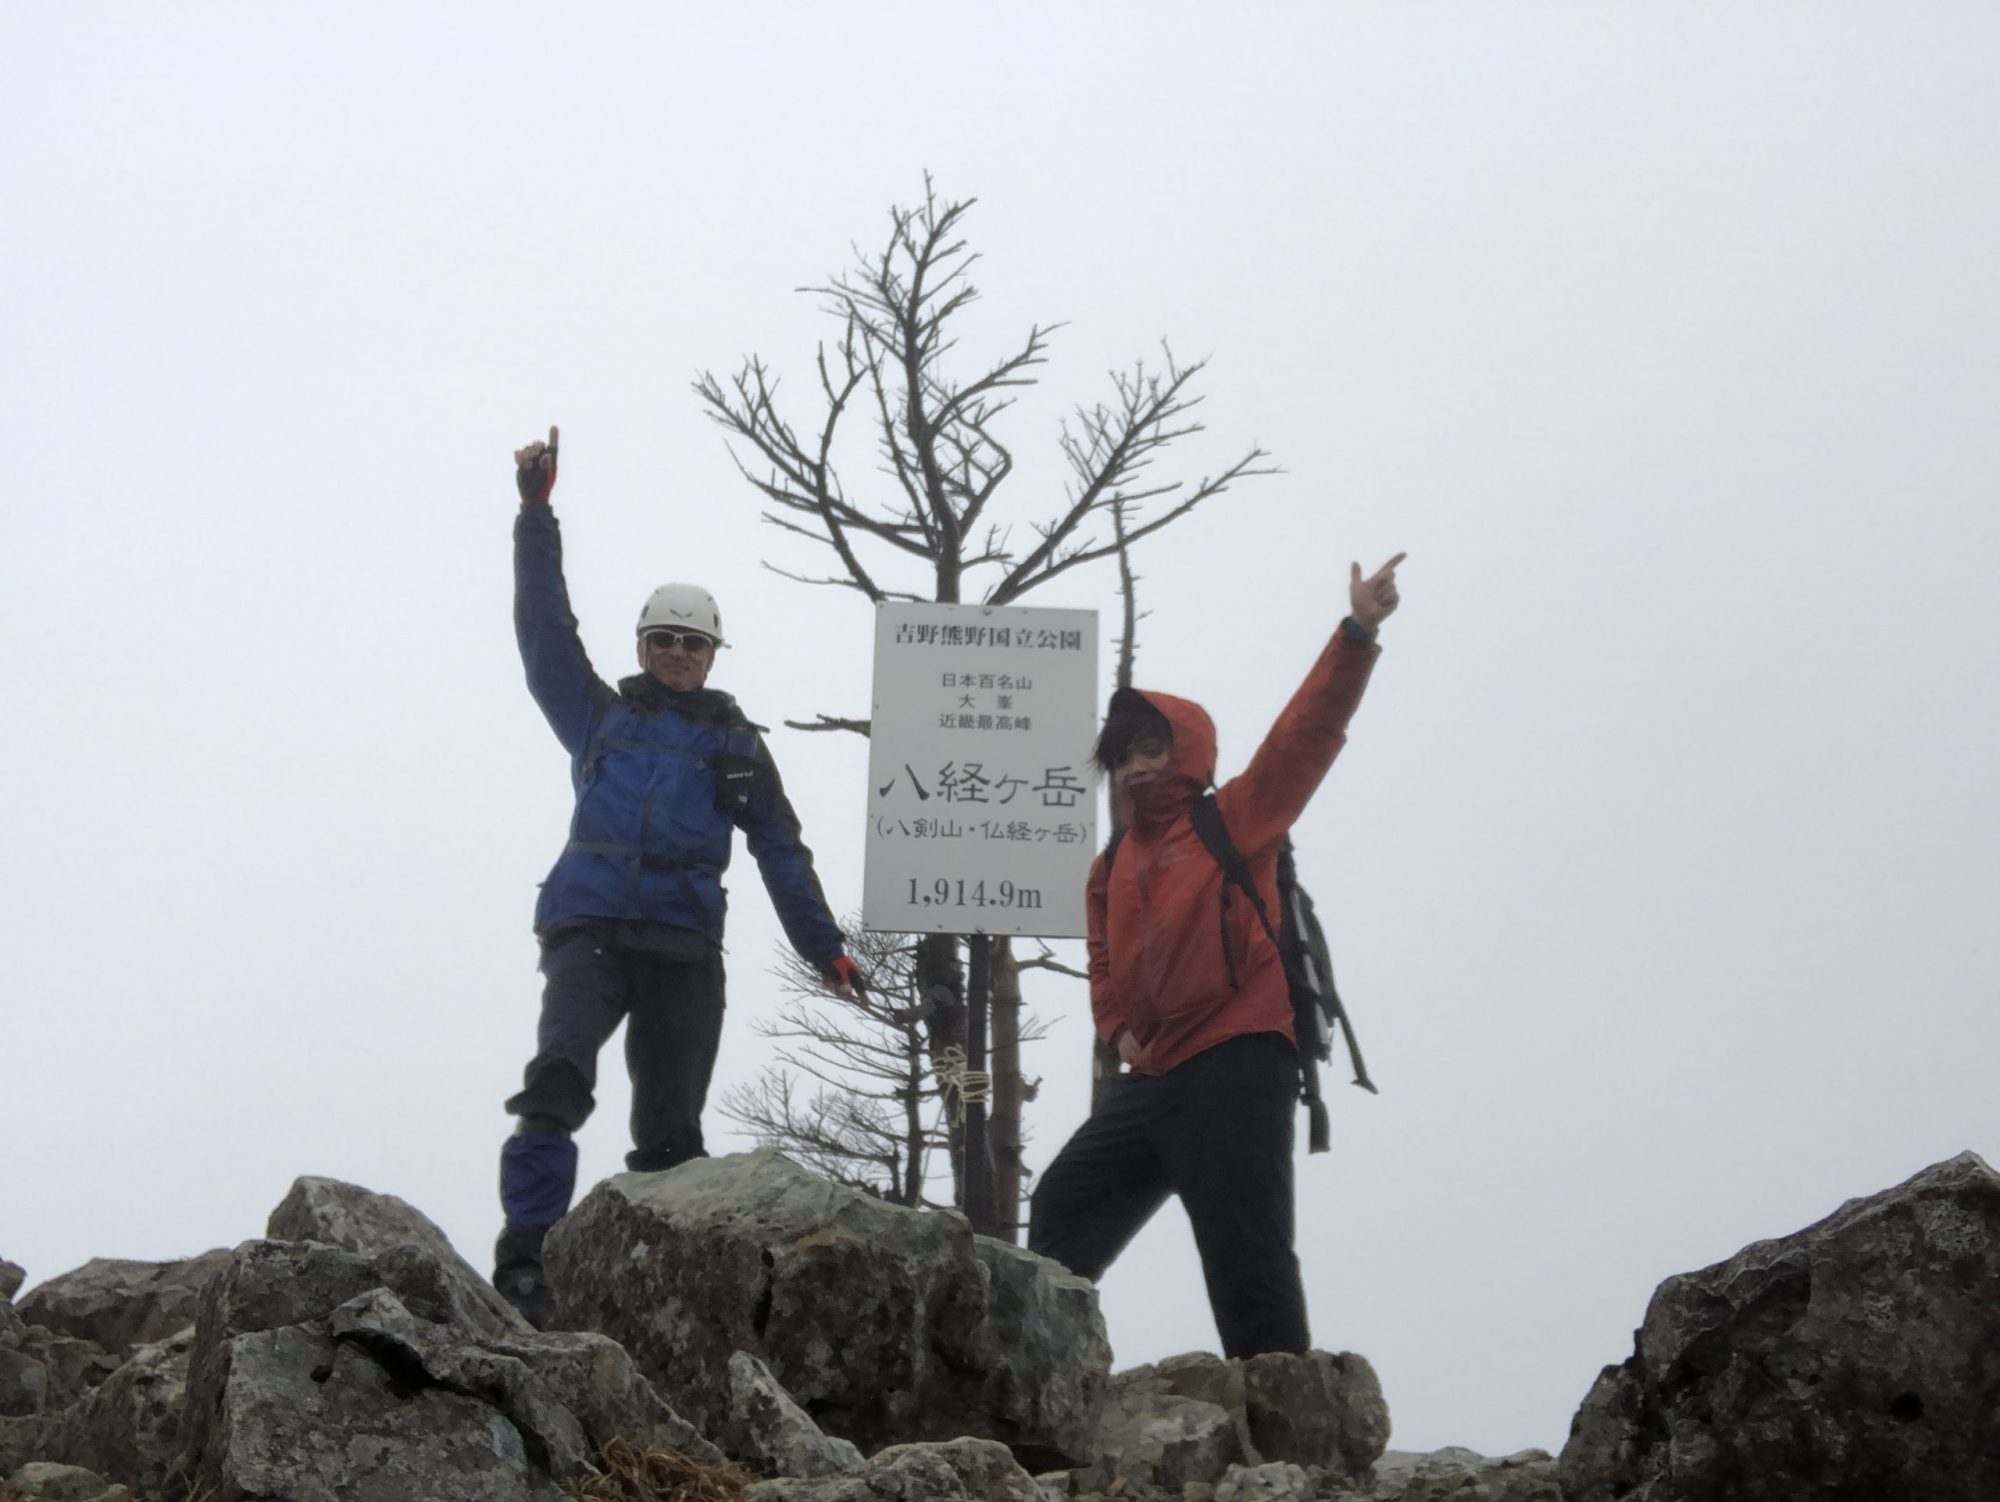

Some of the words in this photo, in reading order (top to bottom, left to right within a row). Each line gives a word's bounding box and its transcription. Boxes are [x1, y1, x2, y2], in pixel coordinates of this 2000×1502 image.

[895, 622, 1082, 651] 吉野熊野国立公園
[942, 672, 1033, 690] 日本百名山
[939, 712, 1032, 731] 近畿最高峰
[907, 877, 1042, 909] 1,914.9m
